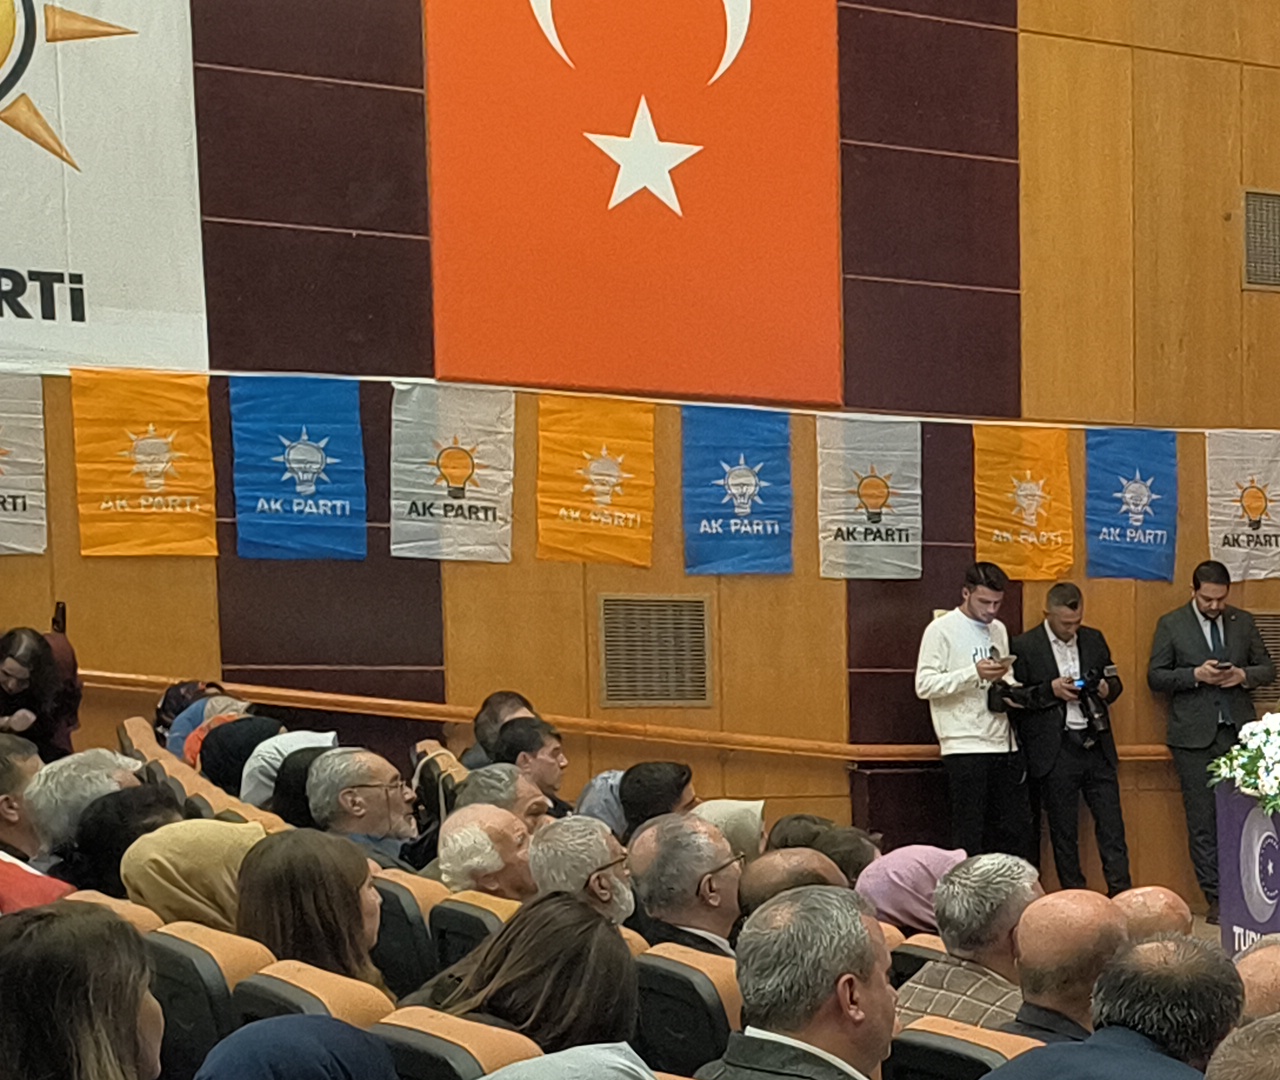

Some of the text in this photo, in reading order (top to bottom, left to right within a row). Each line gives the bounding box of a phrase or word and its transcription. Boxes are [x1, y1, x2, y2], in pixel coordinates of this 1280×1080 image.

[256, 498, 283, 514] AK
[407, 501, 434, 517] AK
[700, 519, 723, 534] AK
[833, 526, 860, 543] AK
[1222, 534, 1242, 548] AK
